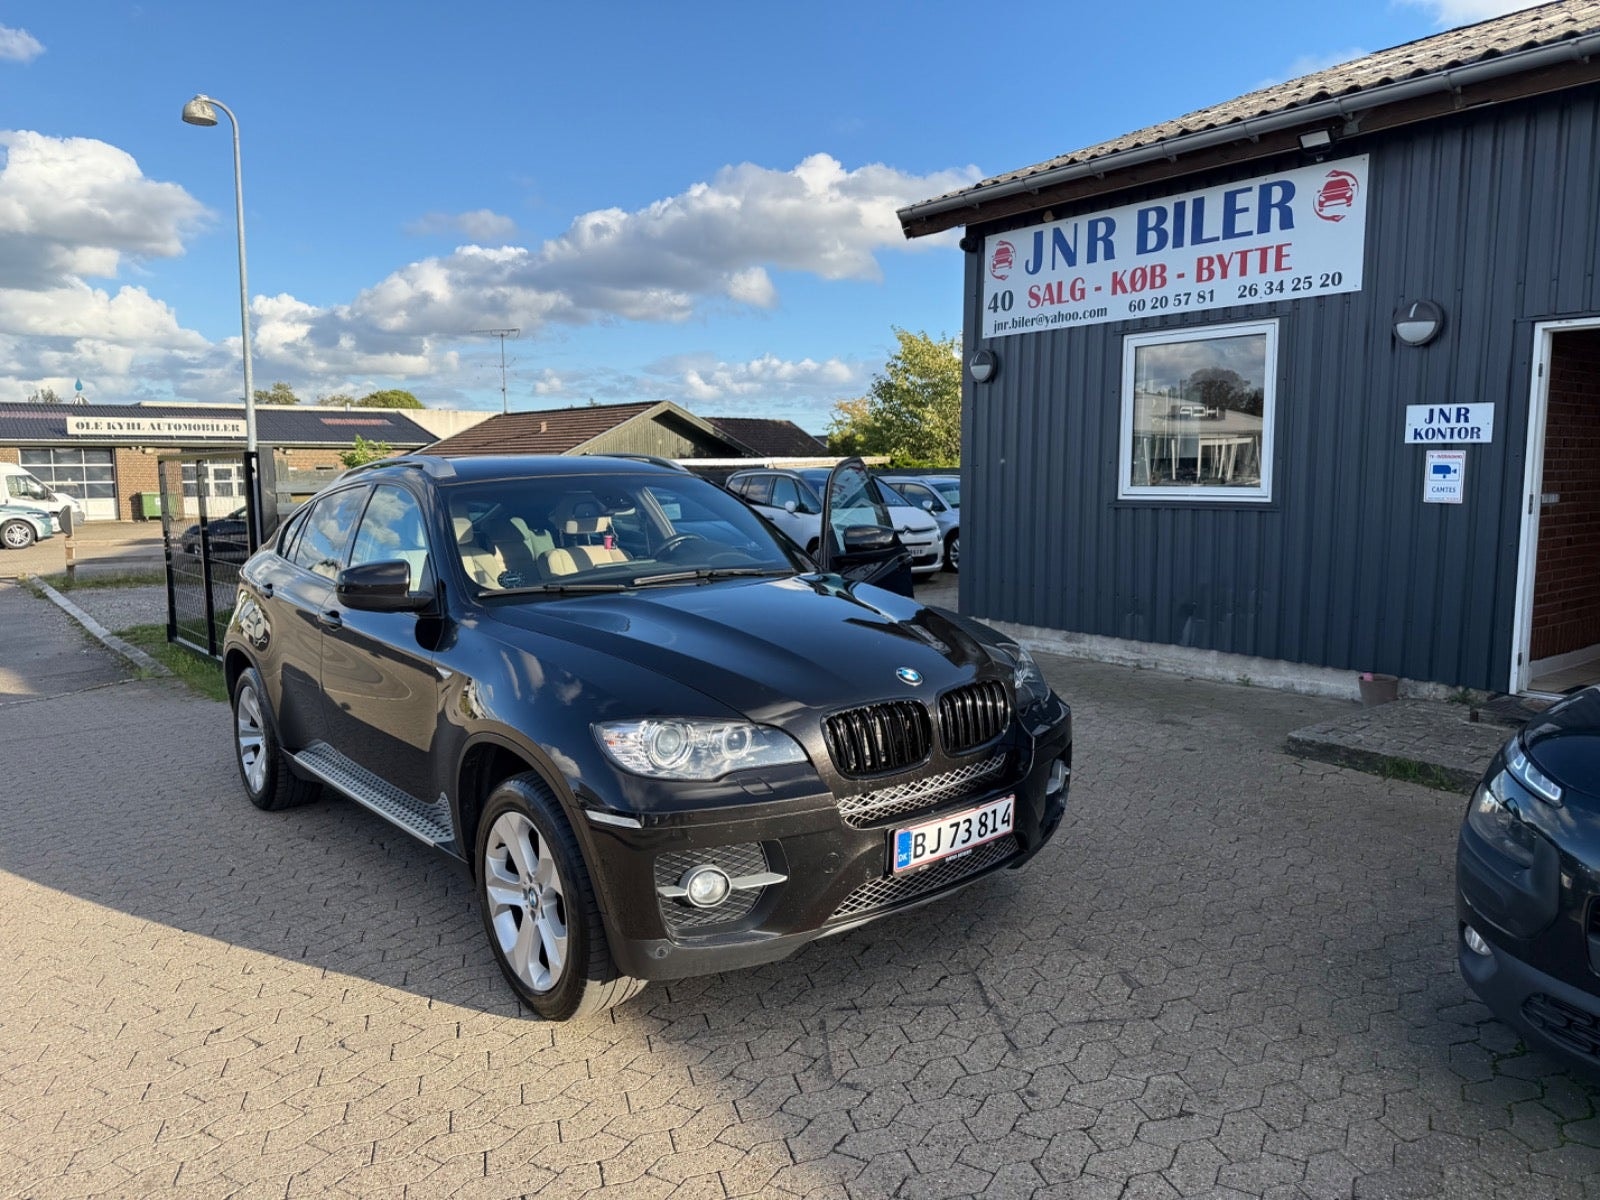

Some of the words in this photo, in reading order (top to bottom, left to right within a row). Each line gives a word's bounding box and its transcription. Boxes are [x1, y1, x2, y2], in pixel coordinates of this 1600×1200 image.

[1025, 216, 1117, 275] JNR
[1136, 179, 1296, 256] BILER
[1027, 276, 1086, 309] SALG
[1111, 263, 1168, 297] KØB
[1195, 243, 1294, 284] BYTTE
[1237, 284, 1258, 299] 26
[1264, 279, 1285, 296] 34
[1291, 275, 1313, 292] 25
[1319, 271, 1343, 289] 20
[988, 290, 1014, 313] 40
[1128, 299, 1146, 313] 60
[1150, 295, 1169, 310] 20
[1173, 292, 1192, 307] 57
[1197, 288, 1215, 304] 81
[993, 306, 1108, 334] jnr.biler@yahoo.com
[75, 421, 103, 431] OLE
[147, 423, 240, 433] AUTOMOBILER
[1424, 407, 1470, 424] JNR
[1413, 426, 1482, 440] KONTOR
[913, 827, 942, 860] BJ
[949, 818, 972, 849] 73
[977, 802, 1012, 839] 814
